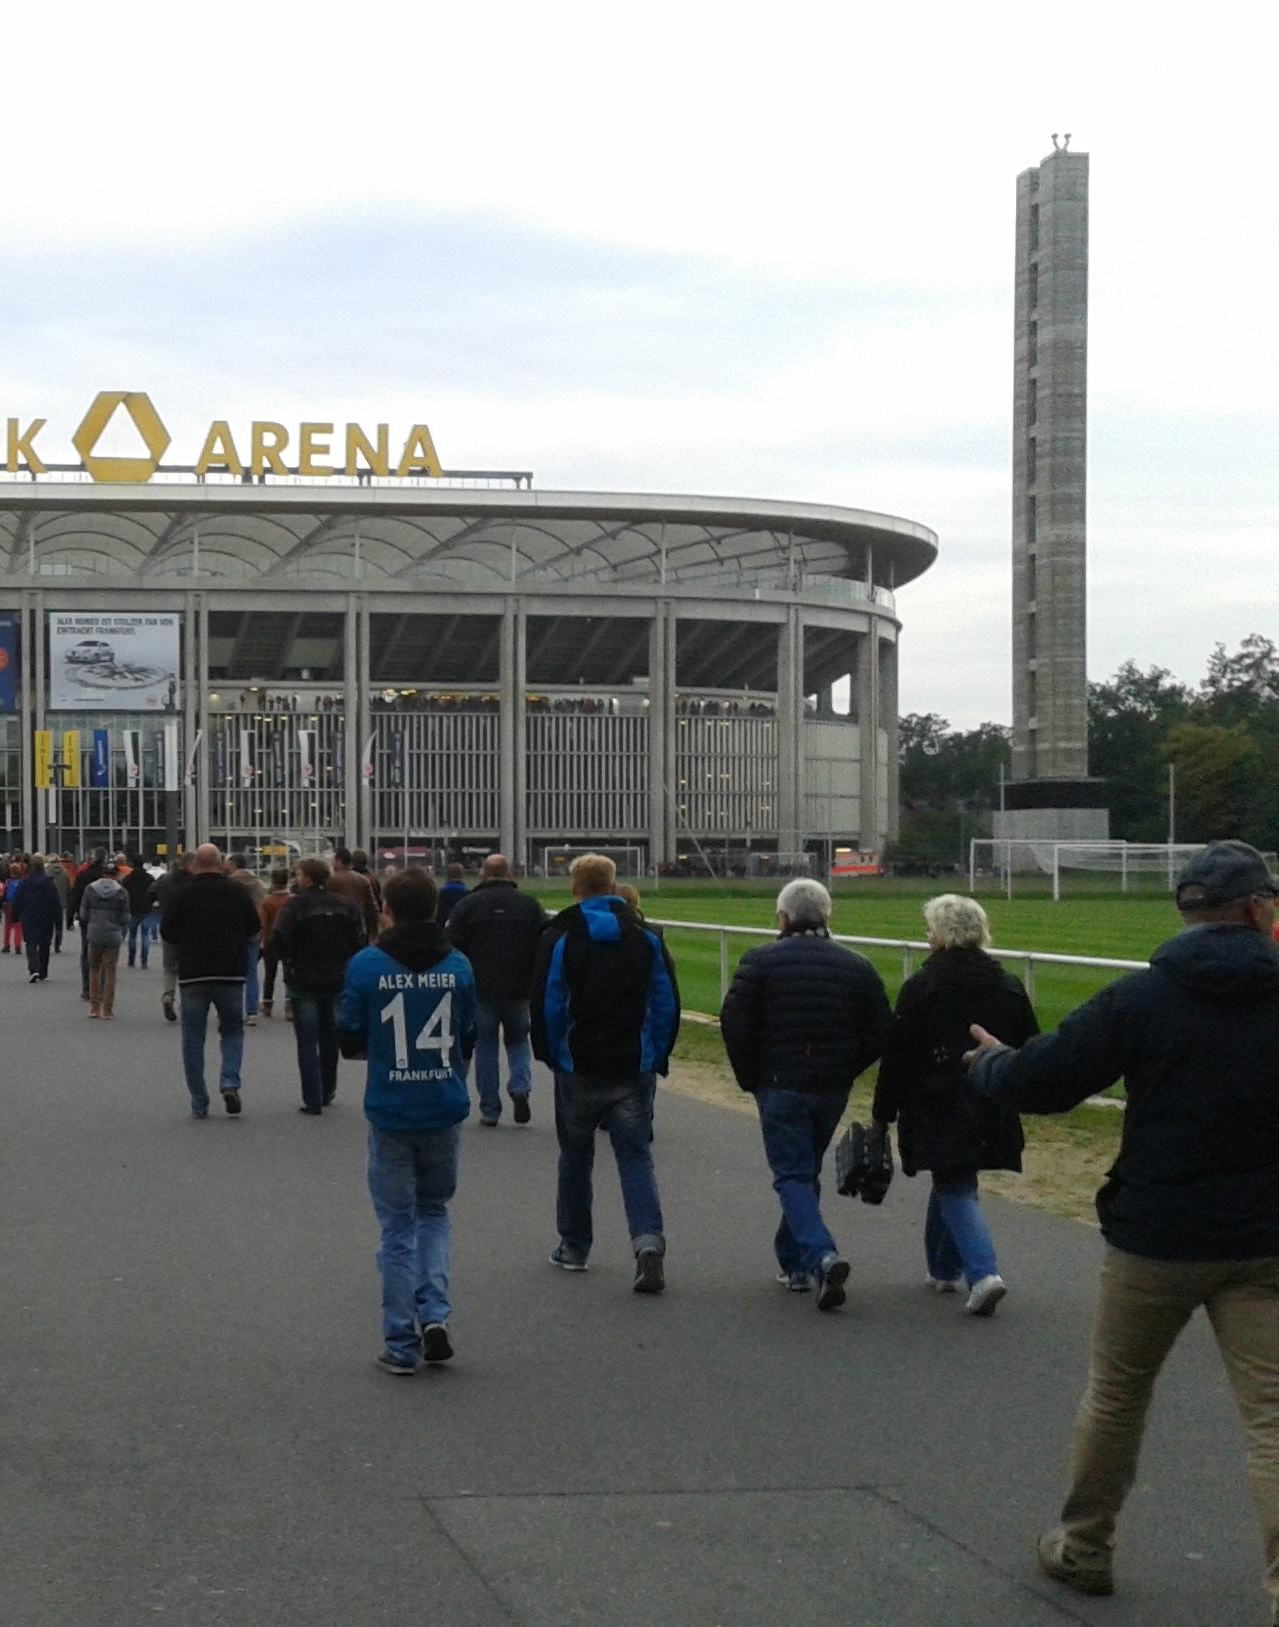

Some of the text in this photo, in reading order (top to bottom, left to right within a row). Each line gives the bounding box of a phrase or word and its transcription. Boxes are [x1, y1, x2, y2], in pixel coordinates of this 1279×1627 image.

[194, 420, 444, 478] ARENA
[378, 973, 456, 990] ALEX MEIER
[380, 990, 455, 1069] 14
[389, 1067, 453, 1082] FRANKFURT
